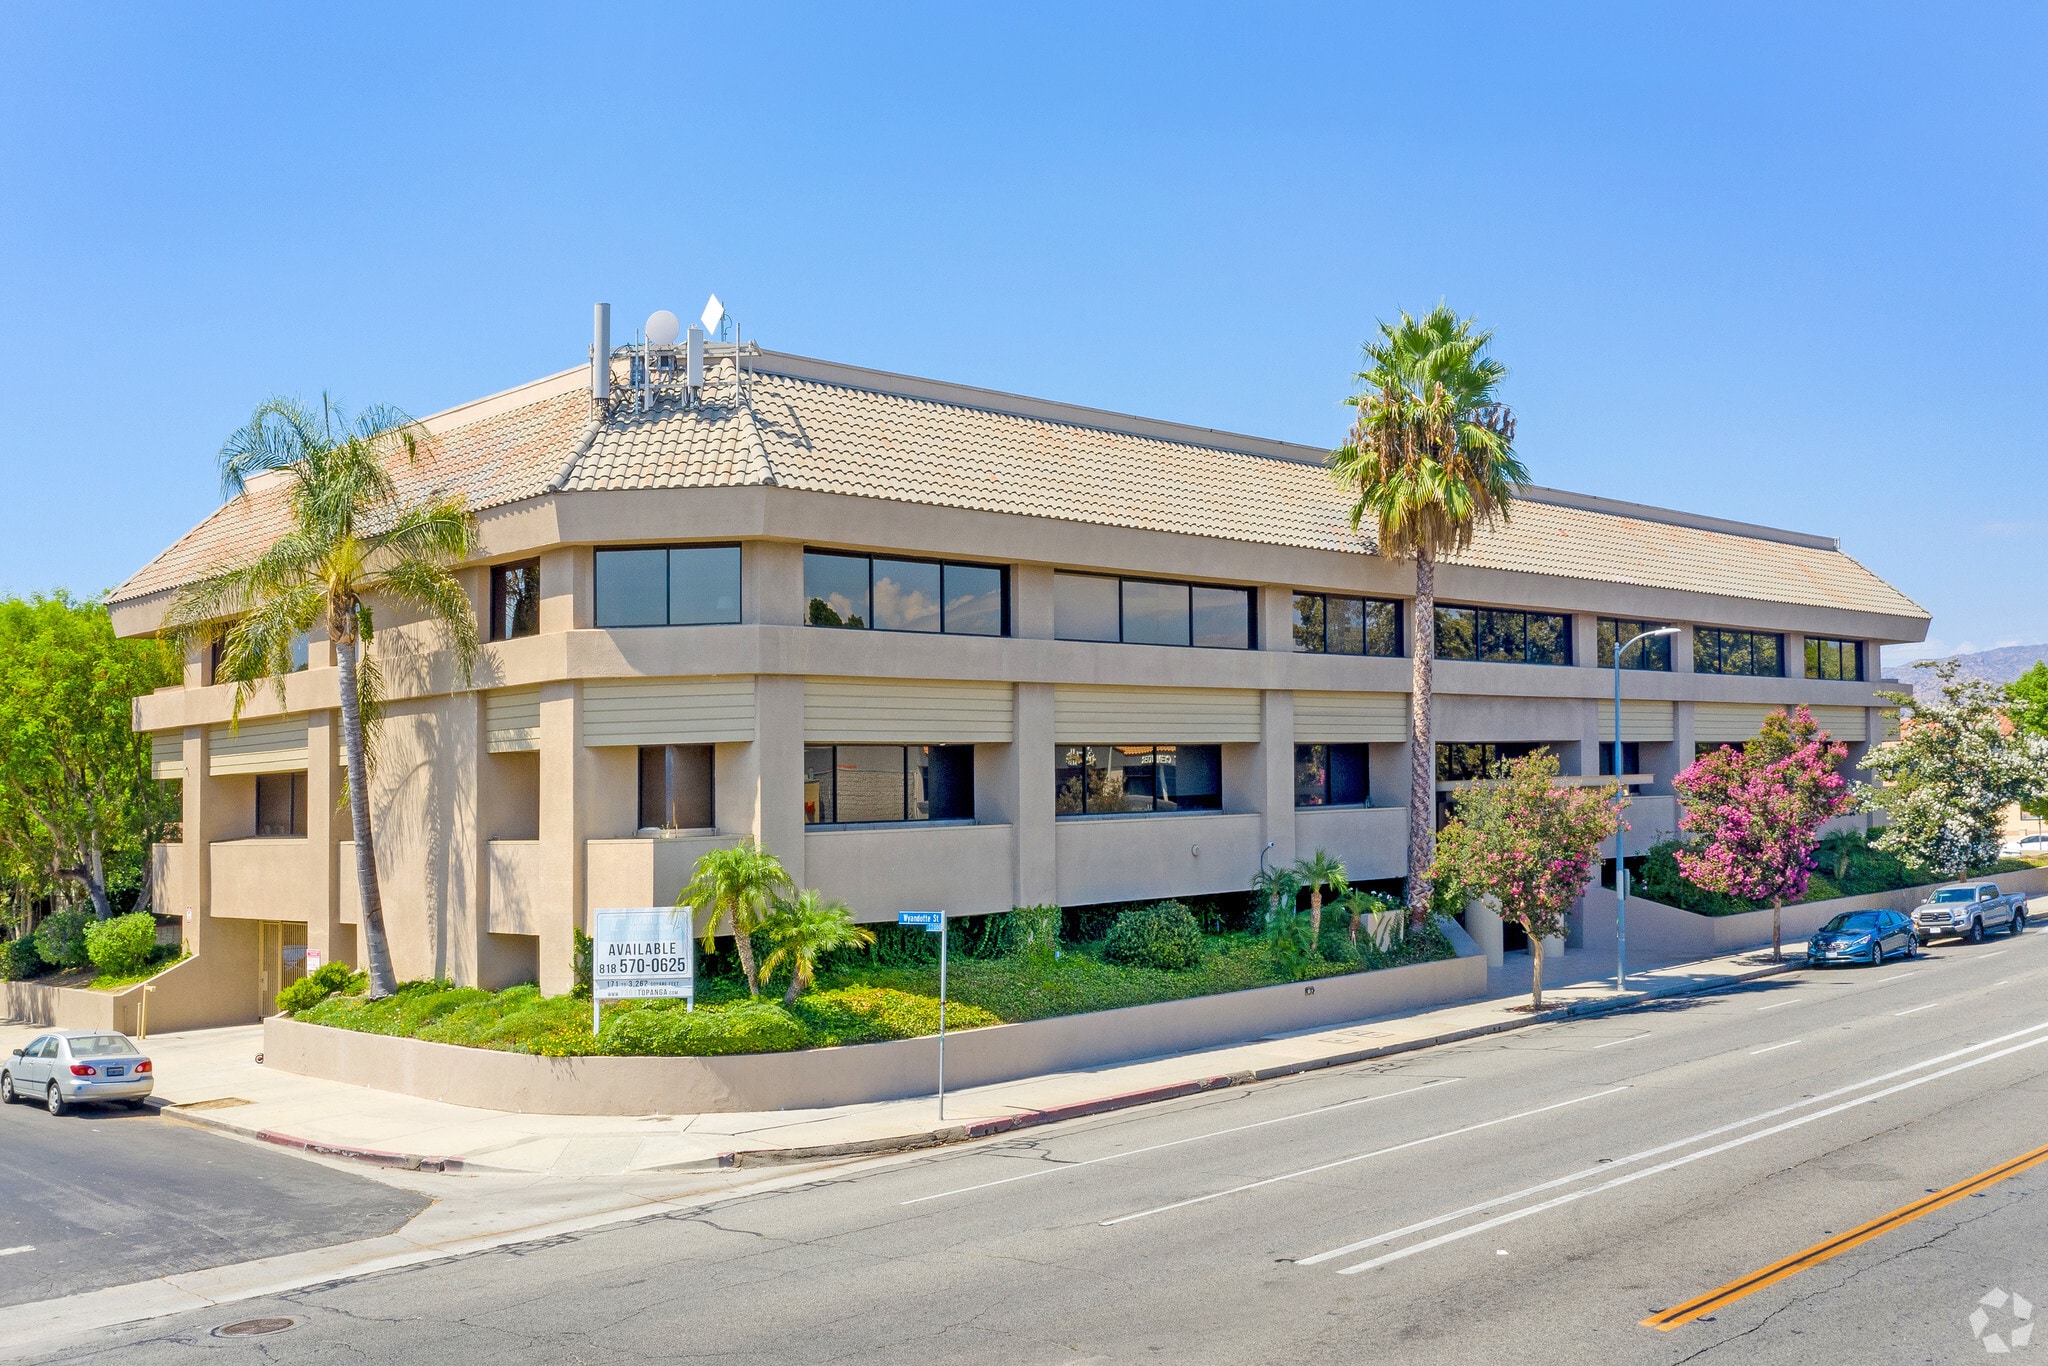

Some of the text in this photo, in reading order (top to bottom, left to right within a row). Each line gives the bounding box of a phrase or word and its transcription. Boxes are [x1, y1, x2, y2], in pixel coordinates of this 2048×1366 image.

[903, 914, 939, 924] Wyandotte St
[608, 942, 676, 956] AVAILABLE
[599, 957, 685, 974] 818 570-0625
[607, 980, 619, 988] 171
